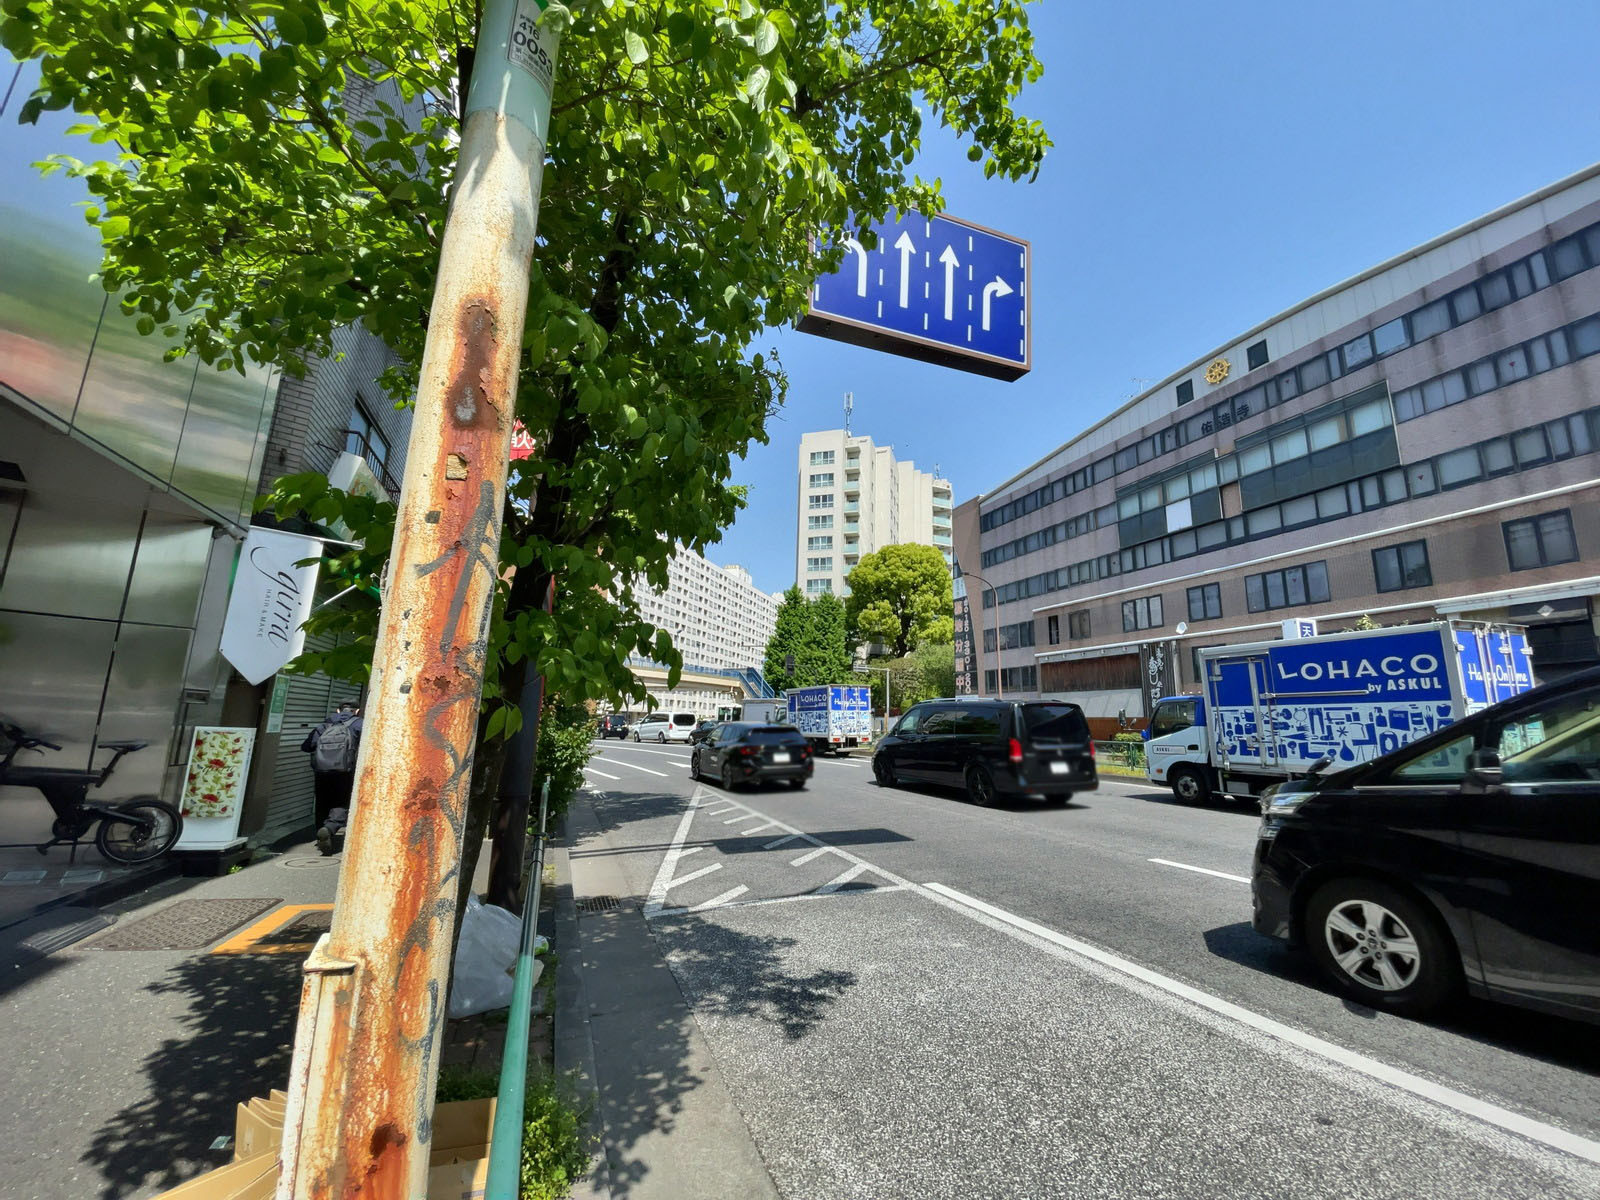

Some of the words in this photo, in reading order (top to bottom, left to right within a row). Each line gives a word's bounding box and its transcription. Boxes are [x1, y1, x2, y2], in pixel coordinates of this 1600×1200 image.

[520, 22, 540, 40] 416
[250, 546, 302, 648] girra
[256, 616, 266, 638] MAKE
[1277, 653, 1438, 681] LOHACO
[1367, 683, 1382, 693] by
[1387, 677, 1442, 691] ASKUL
[800, 694, 827, 703] LOHACO
